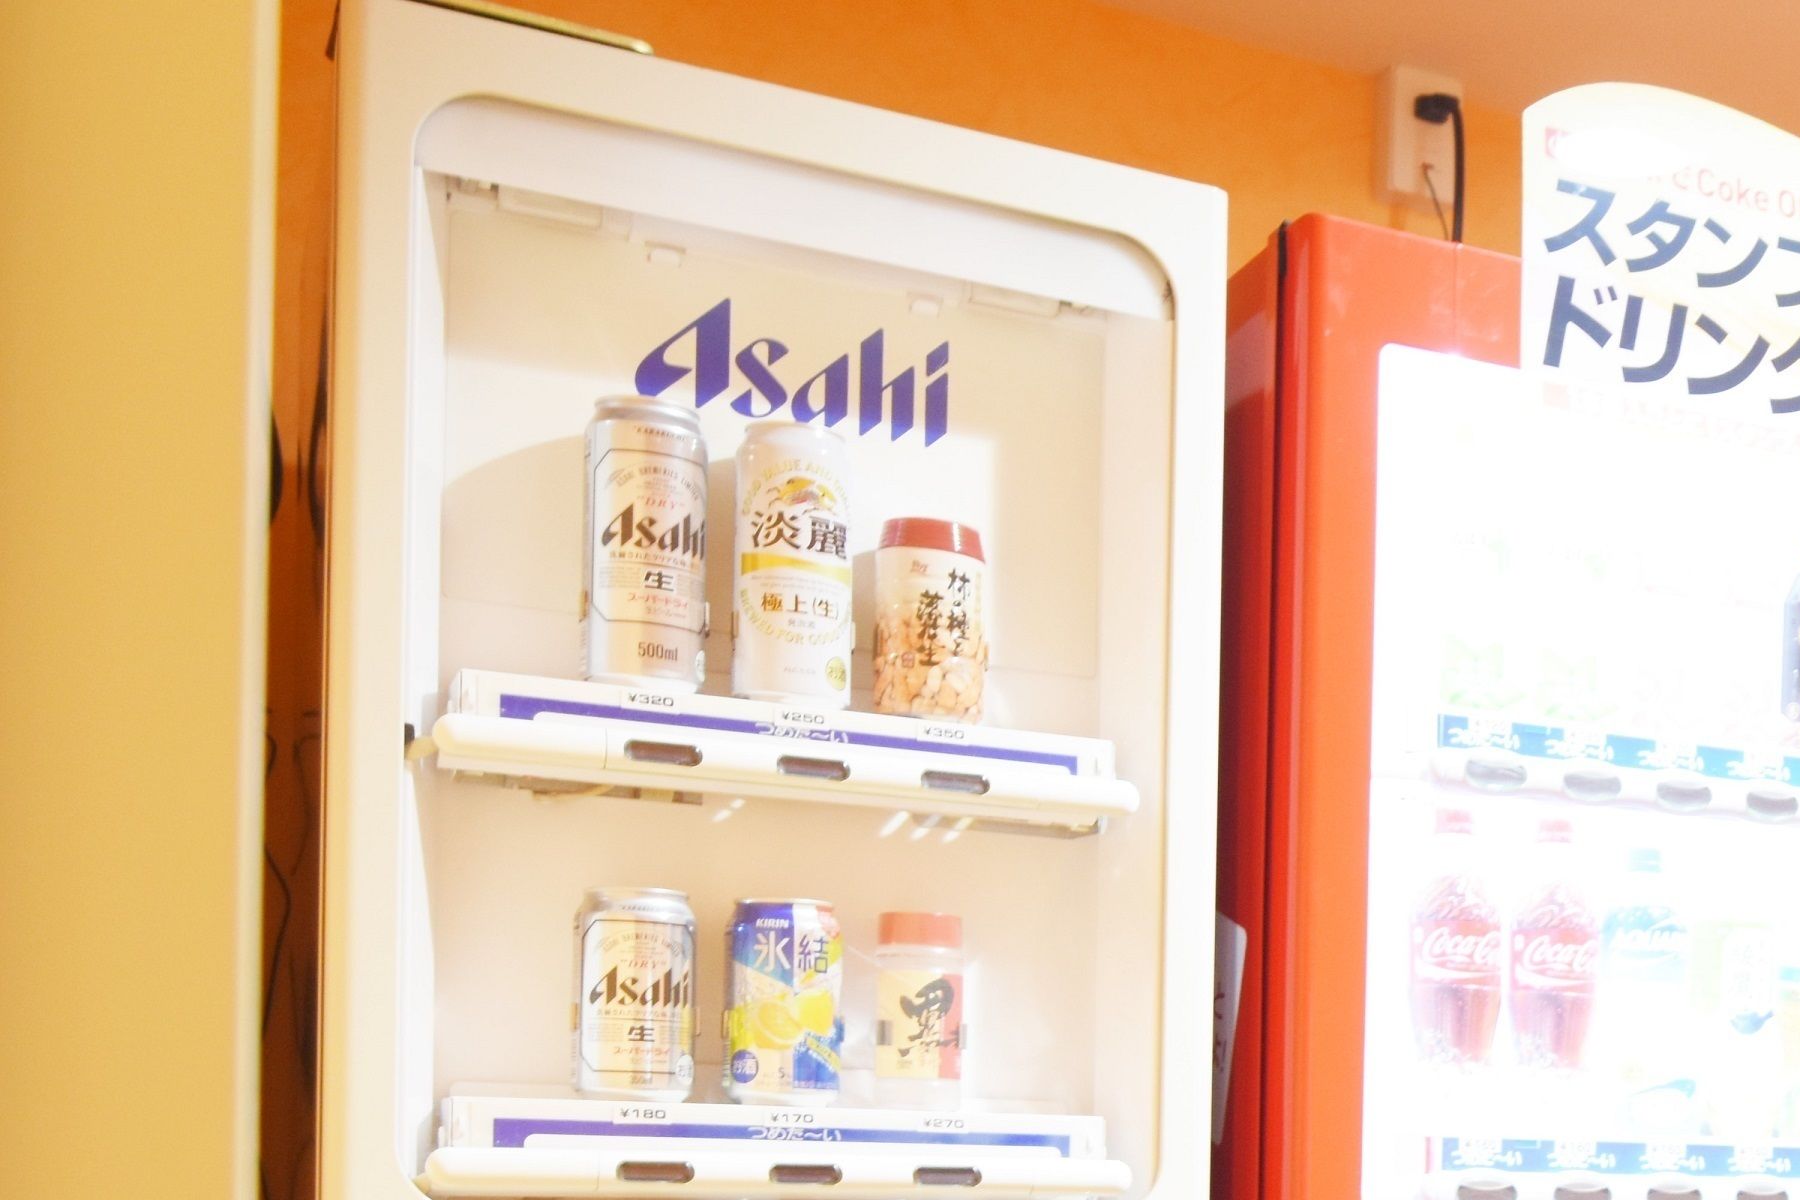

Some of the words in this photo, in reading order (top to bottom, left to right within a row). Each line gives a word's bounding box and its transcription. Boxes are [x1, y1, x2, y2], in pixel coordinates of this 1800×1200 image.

[635, 297, 950, 447] Asahi
[750, 510, 848, 561] 淡麗
[643, 570, 675, 592] 生
[637, 640, 679, 662] 500ml
[626, 693, 675, 708] ¥320
[780, 710, 825, 725] ¥250
[923, 726, 965, 740] ¥350
[755, 917, 790, 929] KIRIN
[752, 930, 830, 975] 氷結
[588, 965, 690, 1009] Asahi
[627, 1024, 656, 1043] 生
[619, 1108, 667, 1120] ¥180
[770, 1112, 815, 1124] ¥170
[923, 1118, 965, 1129] ¥270
